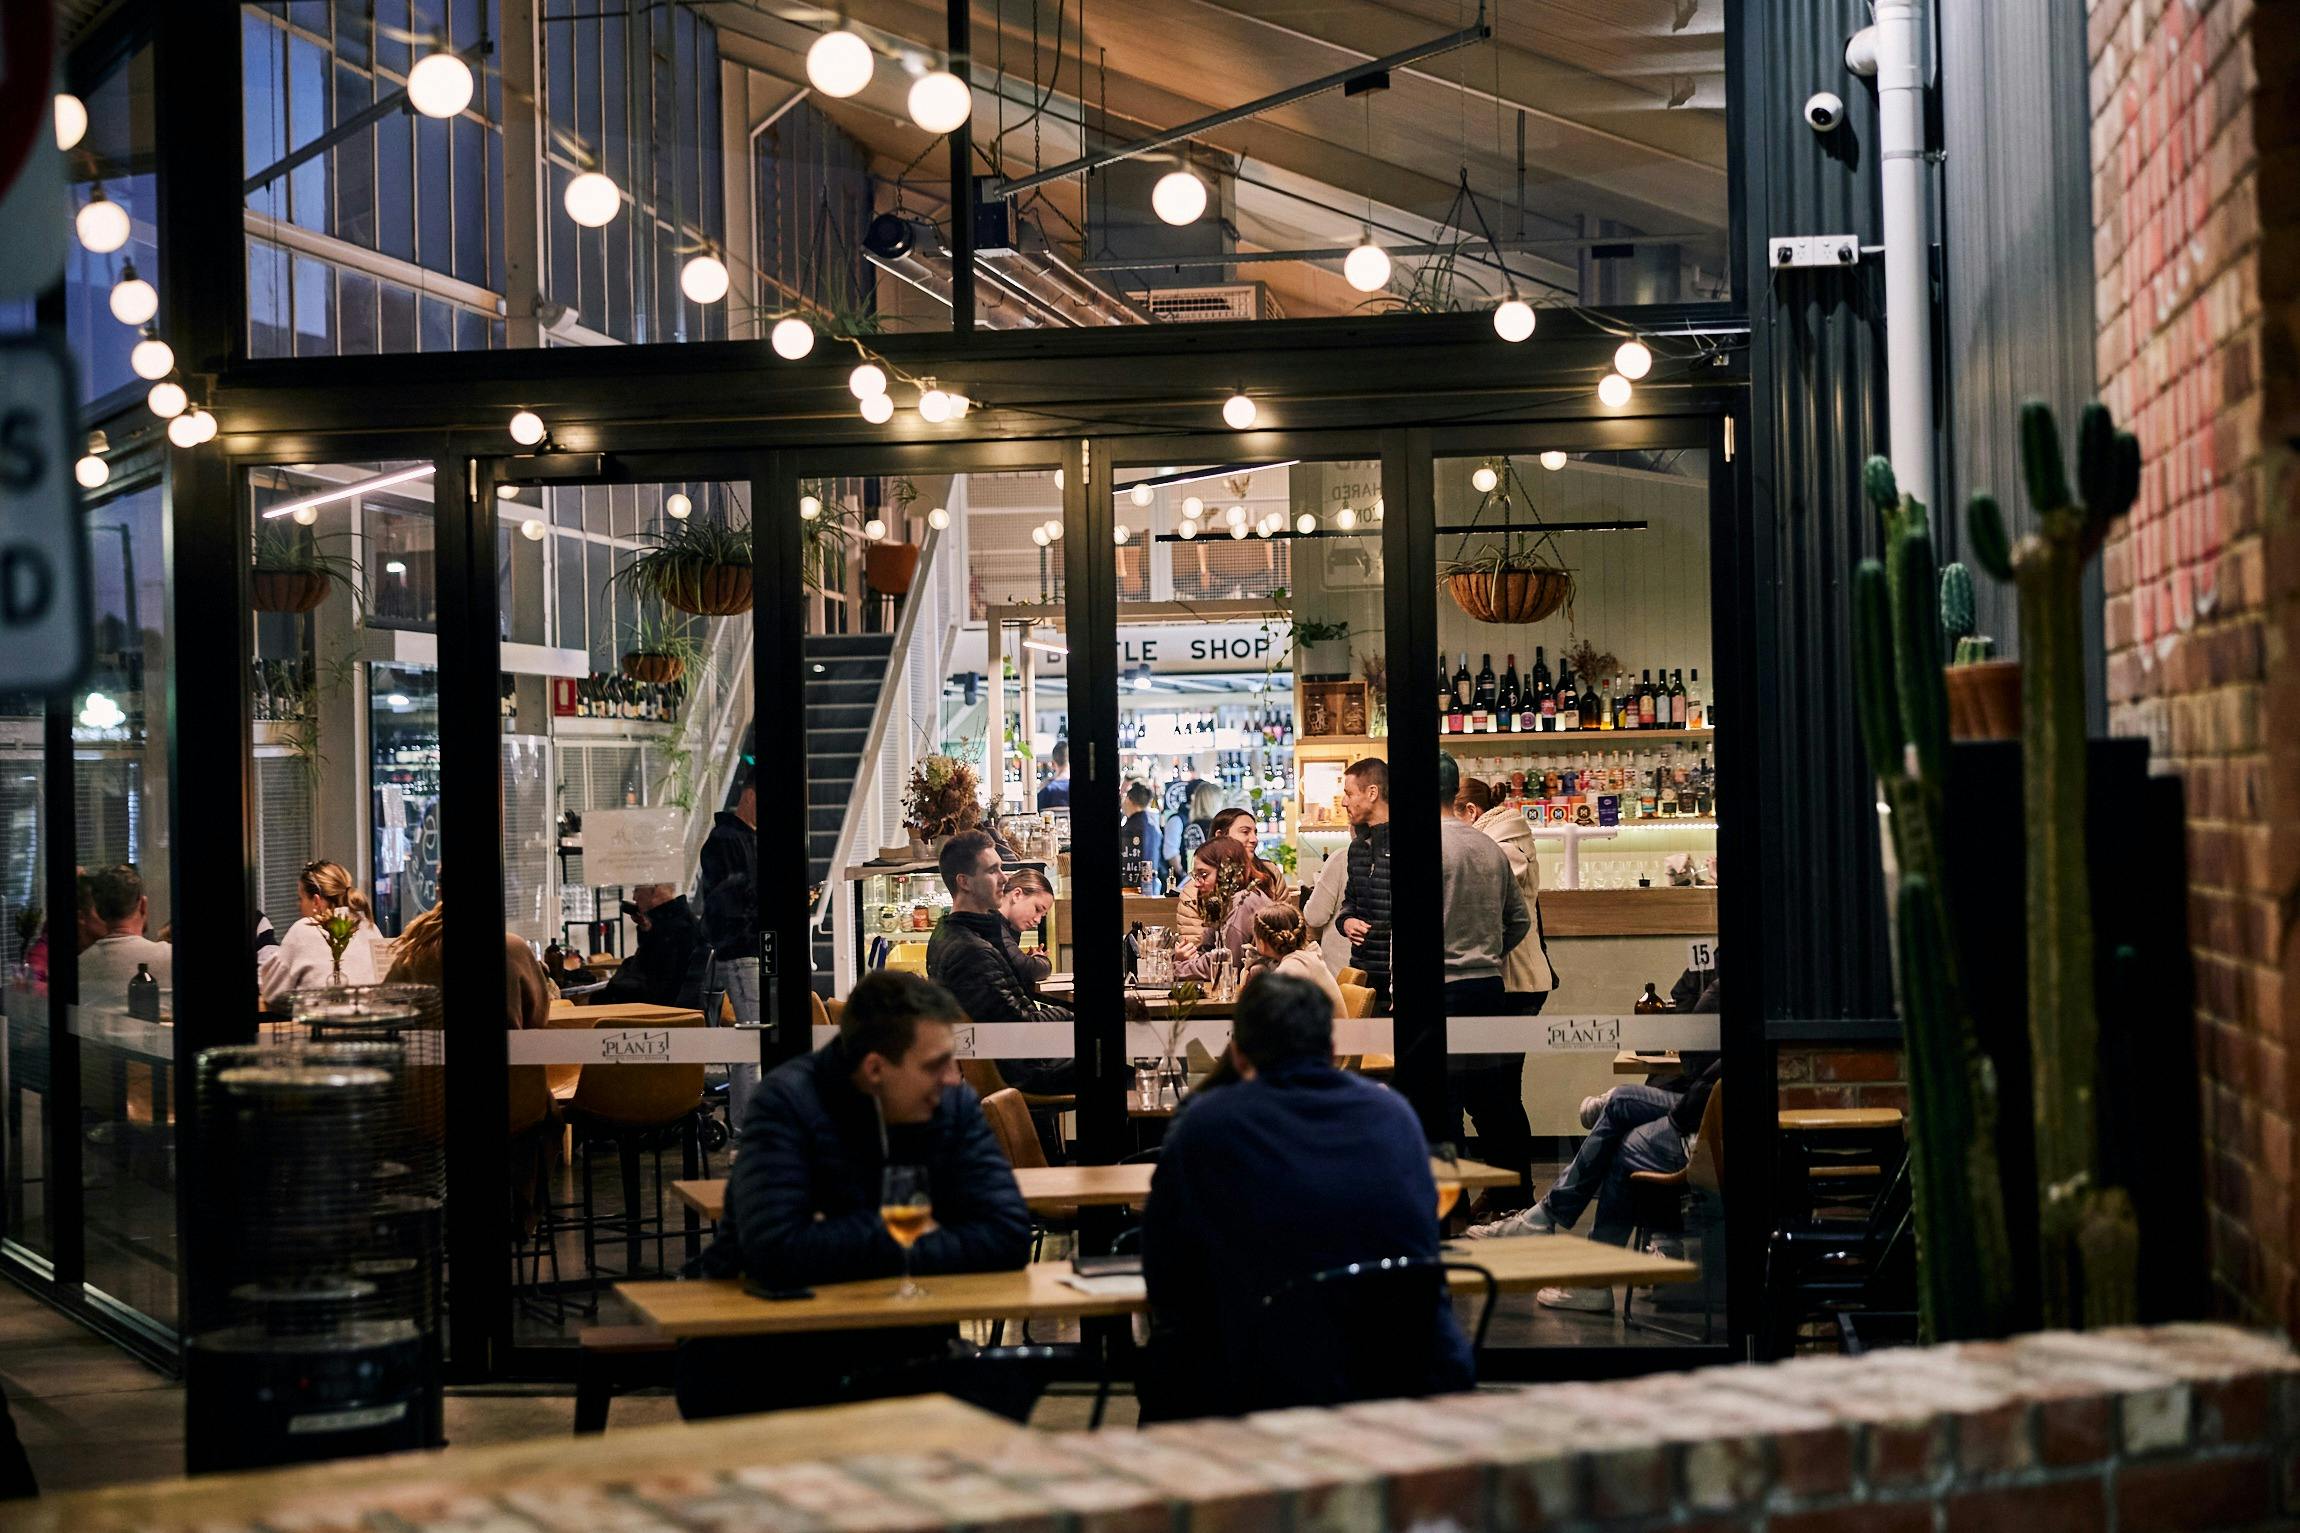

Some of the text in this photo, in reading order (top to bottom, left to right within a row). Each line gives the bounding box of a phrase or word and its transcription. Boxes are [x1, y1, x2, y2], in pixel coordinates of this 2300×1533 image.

[1190, 639, 1270, 659] SHOP
[764, 933, 772, 974] PULL
[1692, 944, 1710, 965] 15
[962, 1037, 971, 1050] 3
[1552, 1028, 1616, 1042] PLANT 3
[606, 1041, 666, 1055] PLANT 3
